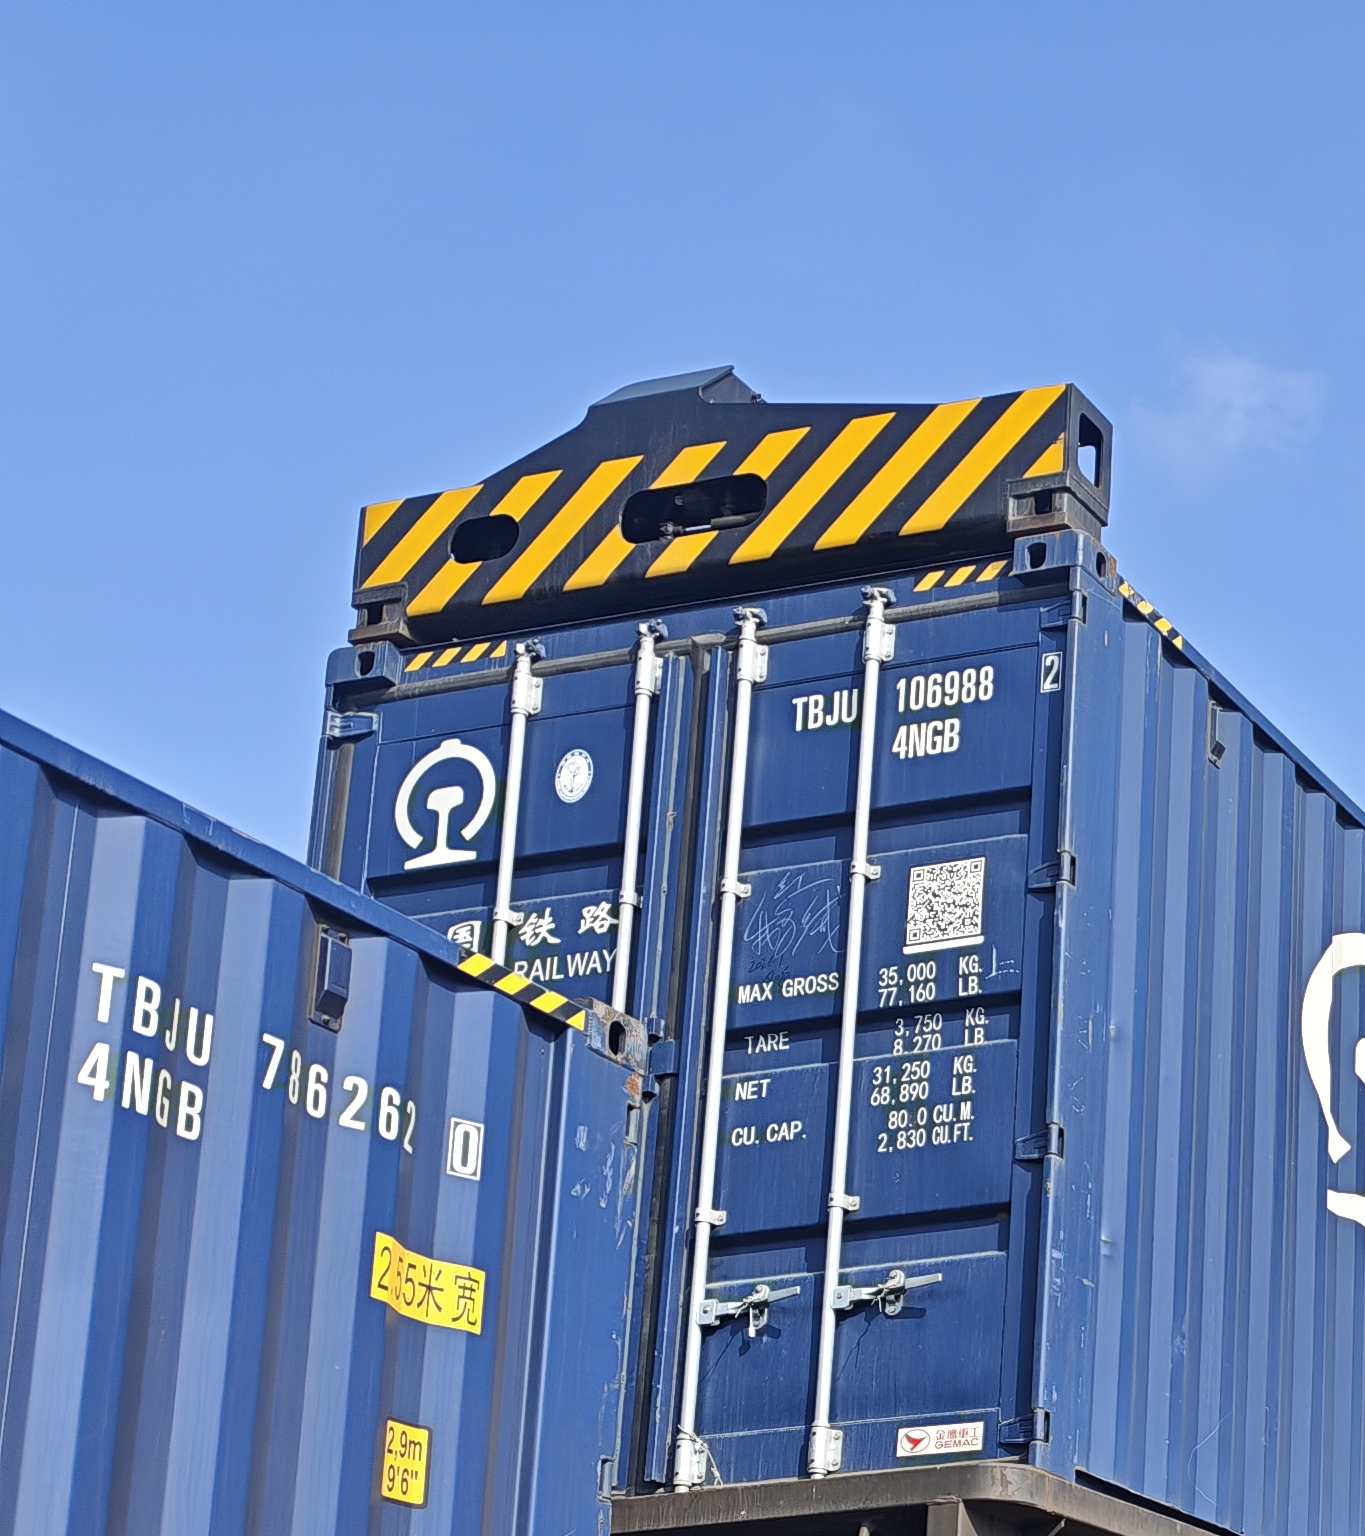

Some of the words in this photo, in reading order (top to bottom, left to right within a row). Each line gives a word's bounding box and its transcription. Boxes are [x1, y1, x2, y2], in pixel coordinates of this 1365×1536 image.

[792, 688, 858, 731] TBJU
[896, 666, 994, 712] 106988
[1042, 655, 1061, 690] 2
[892, 718, 960, 759] 4NGB
[958, 954, 983, 976] KG.
[738, 982, 773, 1006] MAX
[782, 972, 840, 997] GROSS
[958, 976, 983, 997] LB.
[744, 1032, 790, 1055] TARE
[92, 962, 214, 1067] TBJU
[262, 1032, 417, 1155] 786262
[953, 1055, 978, 1075] KG.
[77, 1041, 204, 1141] 4NGB
[735, 1079, 771, 1101] NET
[952, 1076, 976, 1096] LB.
[765, 1121, 808, 1142] CAP.
[934, 1437, 980, 1450] GEMAC
